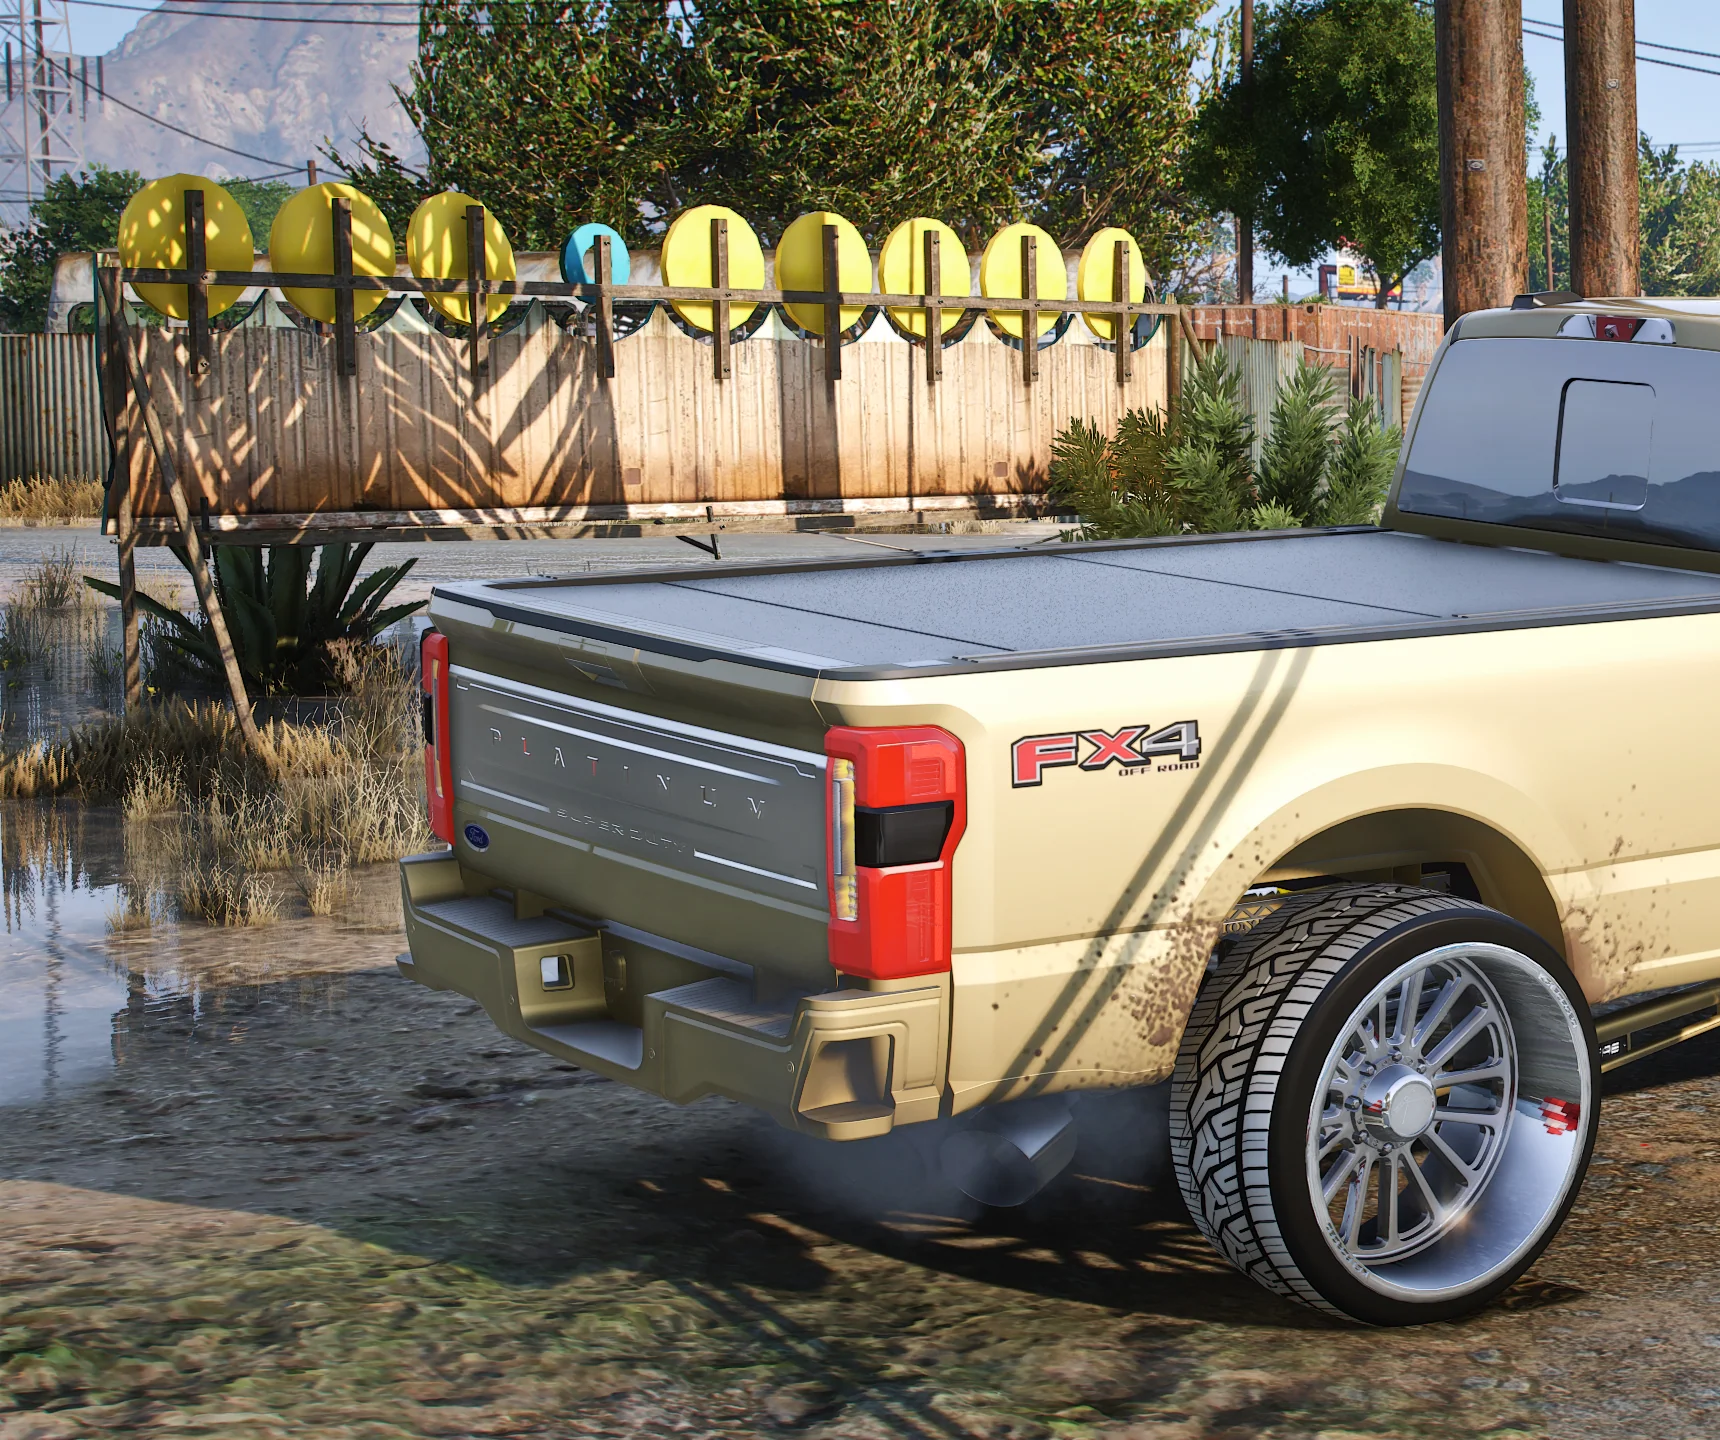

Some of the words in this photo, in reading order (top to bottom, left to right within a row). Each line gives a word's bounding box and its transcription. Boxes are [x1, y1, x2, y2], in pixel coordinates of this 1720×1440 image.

[1011, 719, 1201, 788] FX4
[1118, 766, 1151, 777] OFF
[1157, 761, 1200, 773] ROAD
